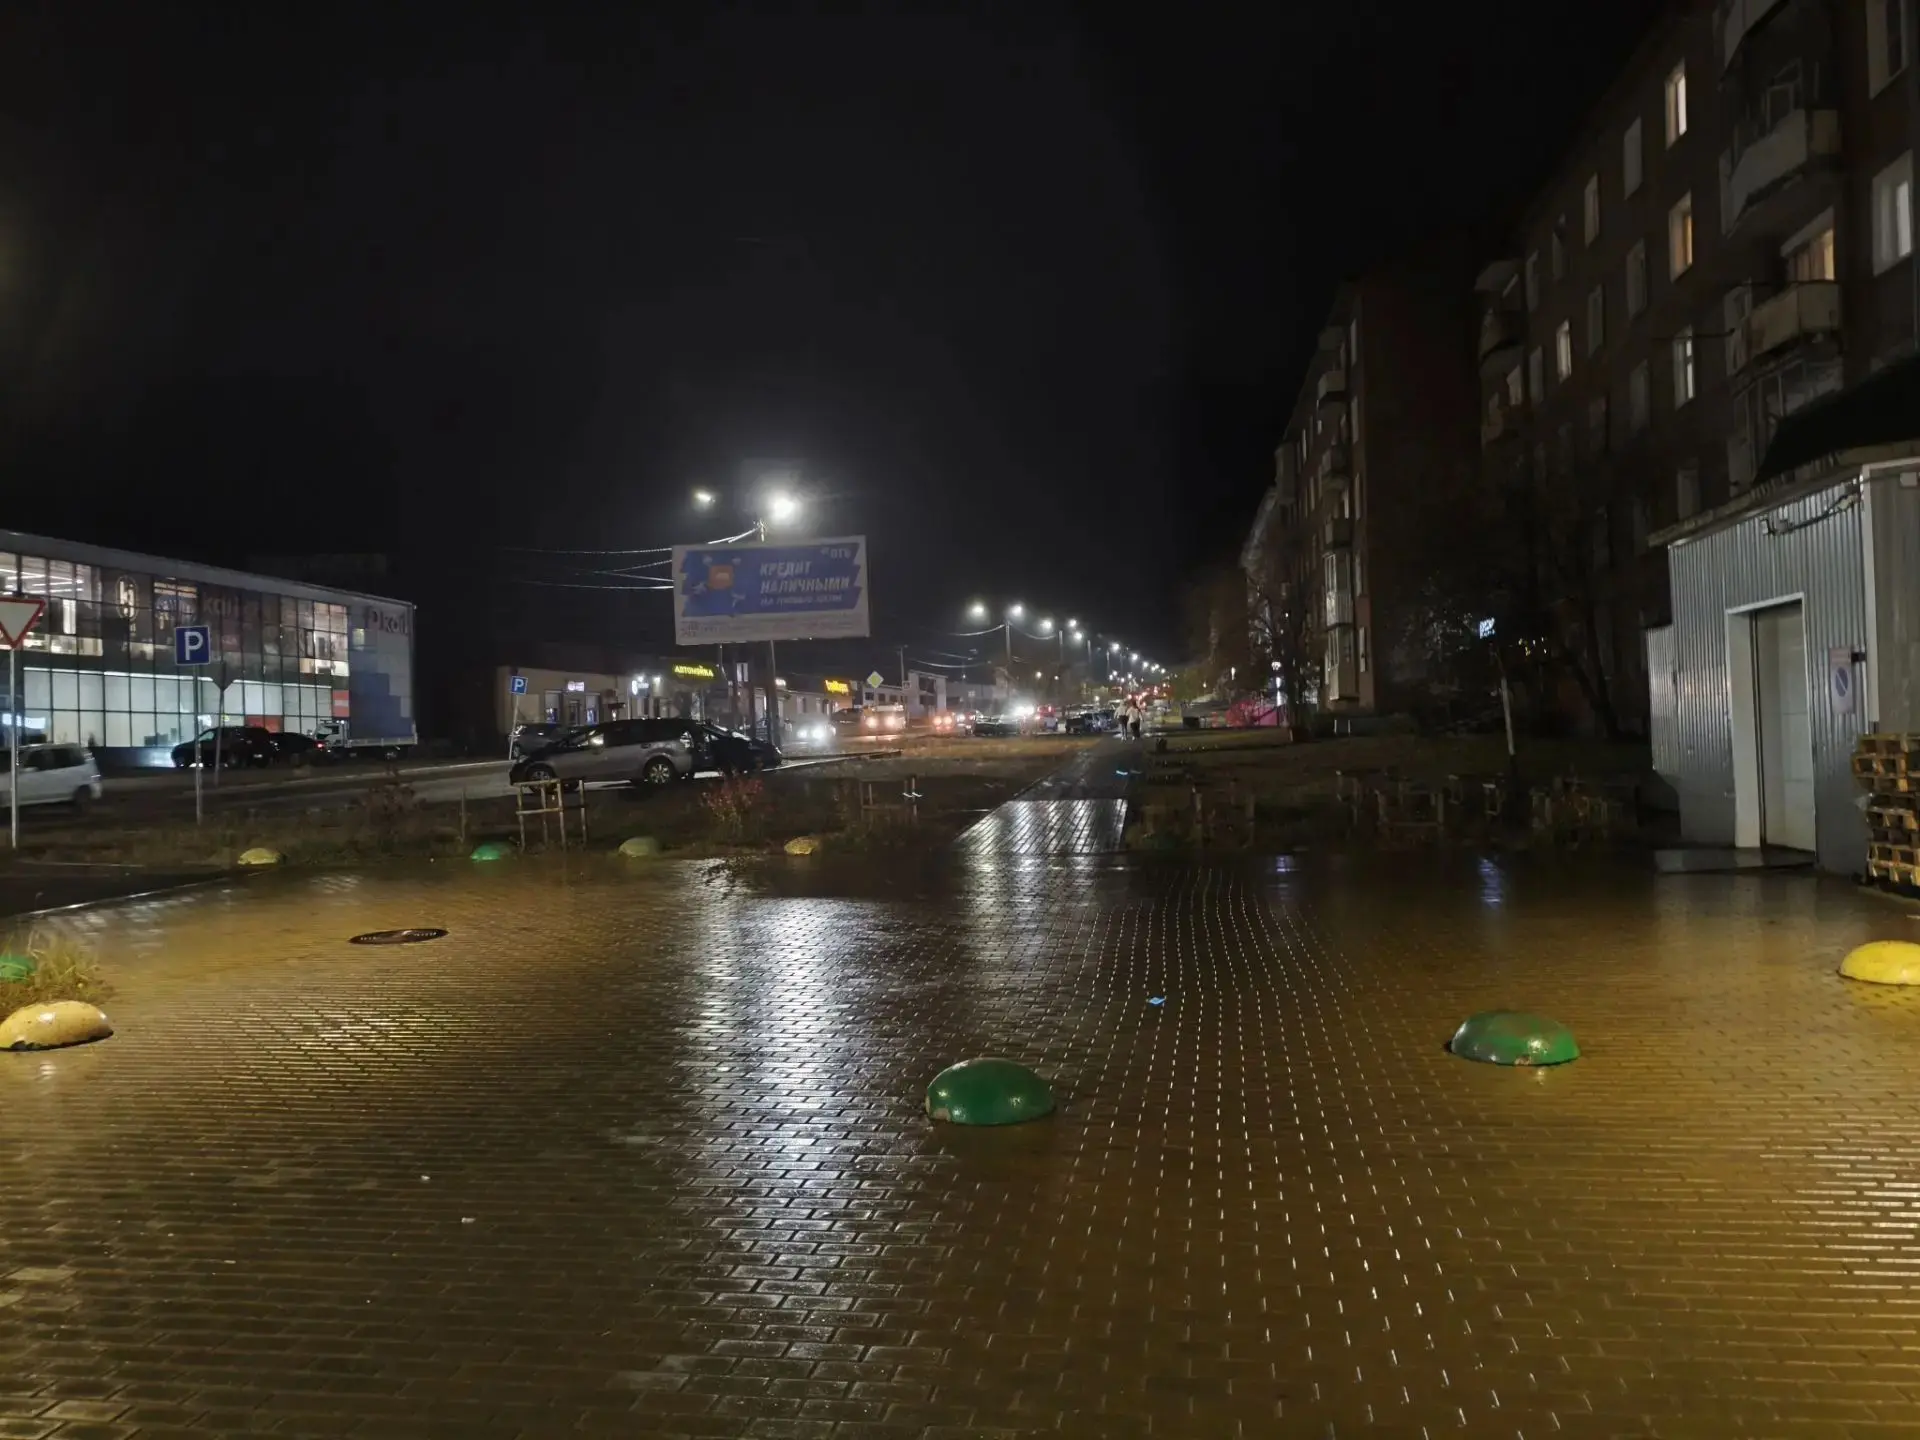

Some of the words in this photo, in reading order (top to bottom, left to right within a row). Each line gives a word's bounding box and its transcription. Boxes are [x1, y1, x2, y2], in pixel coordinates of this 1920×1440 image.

[760, 560, 812, 577] КРЕДИТ
[760, 575, 850, 594] НАЛИЧНЫМИ
[184, 630, 203, 661] P
[514, 678, 525, 691] P
